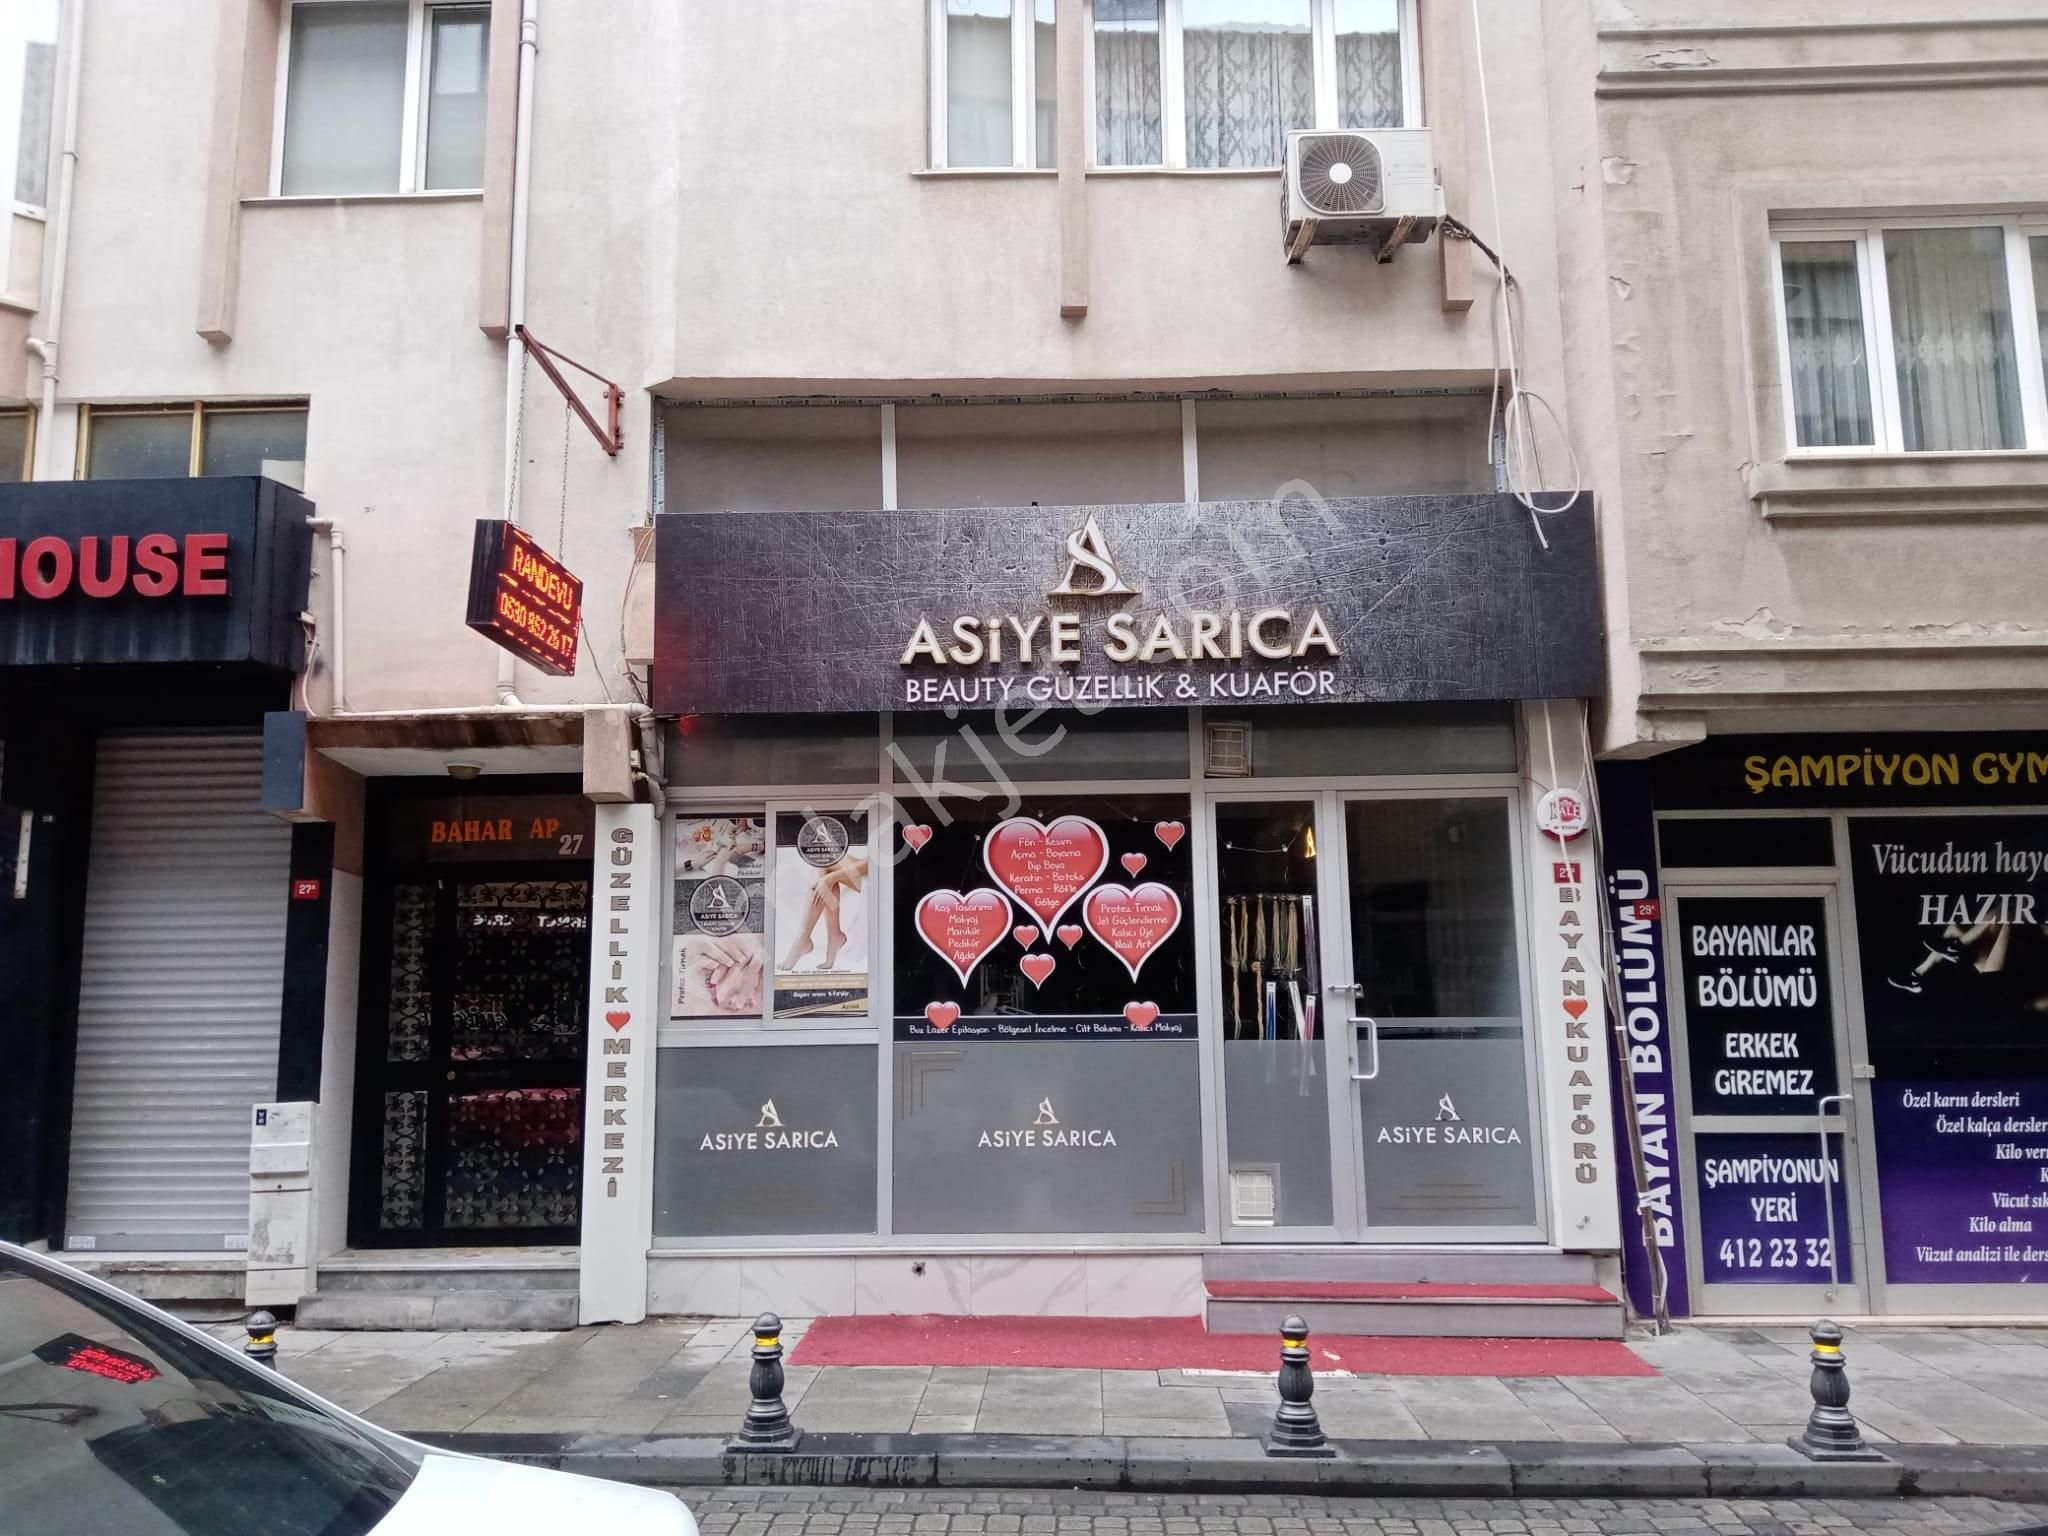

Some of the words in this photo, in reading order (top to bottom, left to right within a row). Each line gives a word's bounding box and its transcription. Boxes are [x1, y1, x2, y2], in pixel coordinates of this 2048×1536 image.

[512, 545, 573, 611] RANDEVU
[500, 592, 527, 627] 0530
[560, 634, 574, 658] 17
[1103, 606, 1341, 663] SARICA
[905, 675, 1015, 703] BEAUTY
[1175, 672, 1196, 700] &
[1209, 665, 1336, 699] KUAFÖR
[1744, 747, 1960, 794] ŞAMPİYON
[431, 818, 513, 843] BAHAR
[529, 817, 561, 839] AP
[558, 834, 584, 855] 27
[1018, 837, 1036, 846] Fön
[1010, 849, 1037, 860] Açma
[1045, 848, 1082, 859] Boyama
[1872, 841, 1989, 874] Vücudun
[1995, 840, 2048, 882] hay
[1043, 860, 1065, 872] Boya
[1009, 873, 1043, 883] Keratin
[1014, 884, 1044, 894] Perma
[1034, 897, 1060, 908] Gölge
[1100, 903, 1132, 913] Protez
[1918, 893, 2038, 925] HAZIR
[948, 914, 979, 925] Makyaj
[1096, 915, 1110, 926] Jel
[1114, 939, 1133, 949] Nail
[1135, 939, 1152, 949] Art
[1692, 925, 1817, 956] BAYANLAR
[953, 950, 976, 962] Ağda
[1698, 967, 1818, 1008] BÖLÜMÜ
[909, 1025, 924, 1034] Buz
[926, 1025, 949, 1034] Lazer
[951, 1024, 990, 1036] Epilasyon
[998, 1023, 1032, 1036] Bölgesel
[1075, 1023, 1092, 1033] Cilt
[1155, 1022, 1183, 1033] Makyaj
[1725, 1033, 1800, 1059] ERKEK
[1565, 1022, 1598, 1184] KUAFÖRÜ
[1902, 1089, 1931, 1108] Özel
[1933, 1091, 1968, 1107] karın
[1971, 1091, 2020, 1107] dersleri
[1936, 1114, 1965, 1133] Özel
[1967, 1116, 2001, 1137] kalça
[764, 1130, 839, 1149] SARICA
[1041, 1129, 1117, 1148] SARICA
[1444, 1126, 1521, 1145] SARICA
[1995, 1143, 2022, 1160] Kilo
[1636, 1093, 1675, 1247] BAYAN
[1704, 1153, 1840, 1189] ŞAMPİYONUN
[1751, 1191, 1798, 1222] YERİ
[1992, 1192, 2029, 1208] Vücut
[1969, 1215, 1996, 1233] Kilo
[1999, 1215, 2033, 1233] alma
[1719, 1238, 1763, 1268] 412
[1769, 1238, 1798, 1268] 23
[1805, 1238, 1833, 1268] 32
[1915, 1245, 1954, 1263] Vüzut
[1956, 1245, 2001, 1263] analizi
[2004, 1245, 2020, 1263] ile
